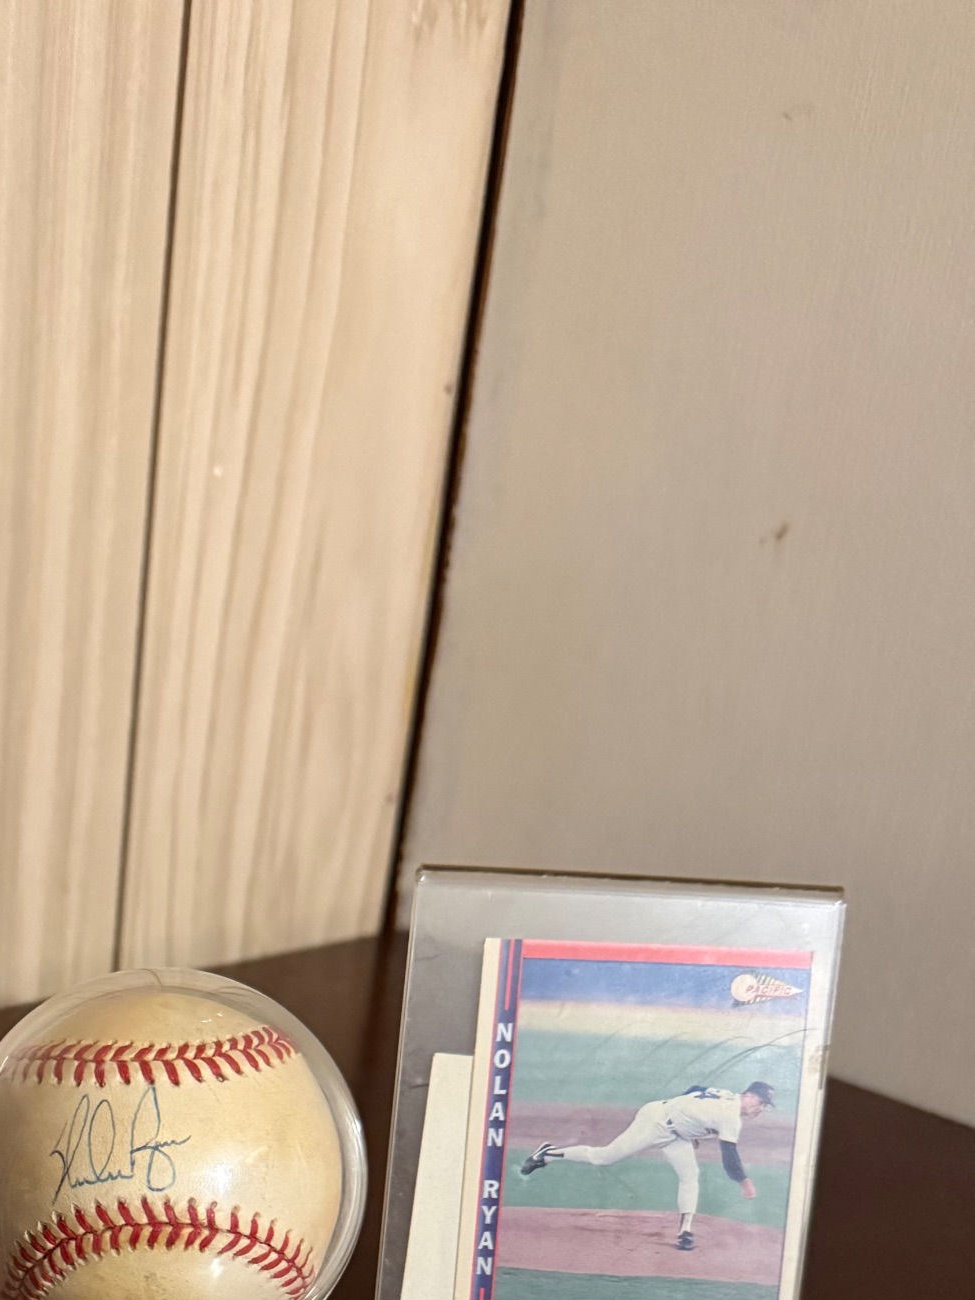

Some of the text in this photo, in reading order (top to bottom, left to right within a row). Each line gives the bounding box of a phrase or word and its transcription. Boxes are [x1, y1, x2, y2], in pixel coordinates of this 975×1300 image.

[744, 984, 793, 996] PACIFIC
[475, 1021, 515, 1278] NOLAN RYAN
